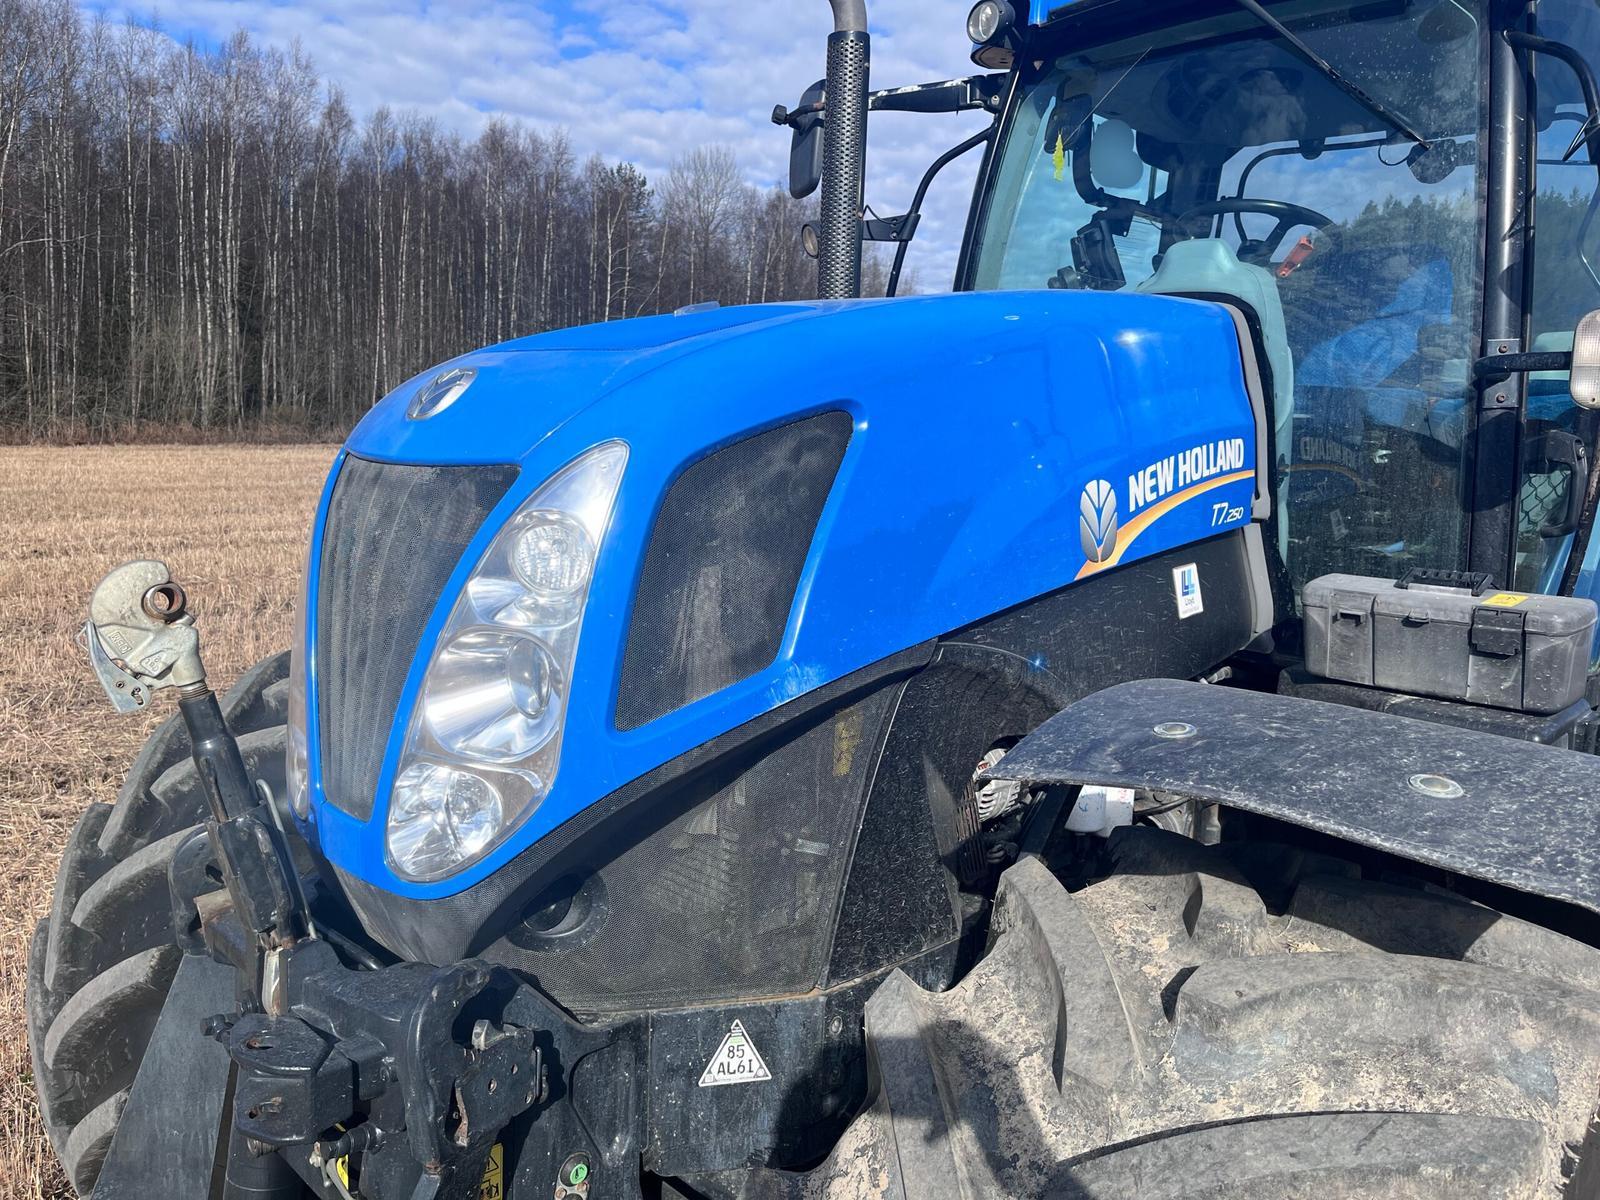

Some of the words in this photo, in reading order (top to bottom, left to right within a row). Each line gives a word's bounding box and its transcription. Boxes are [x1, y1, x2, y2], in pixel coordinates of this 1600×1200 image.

[1128, 455, 1175, 513] NEW
[1177, 438, 1245, 488] HOLLAND
[727, 1044, 745, 1059] 85
